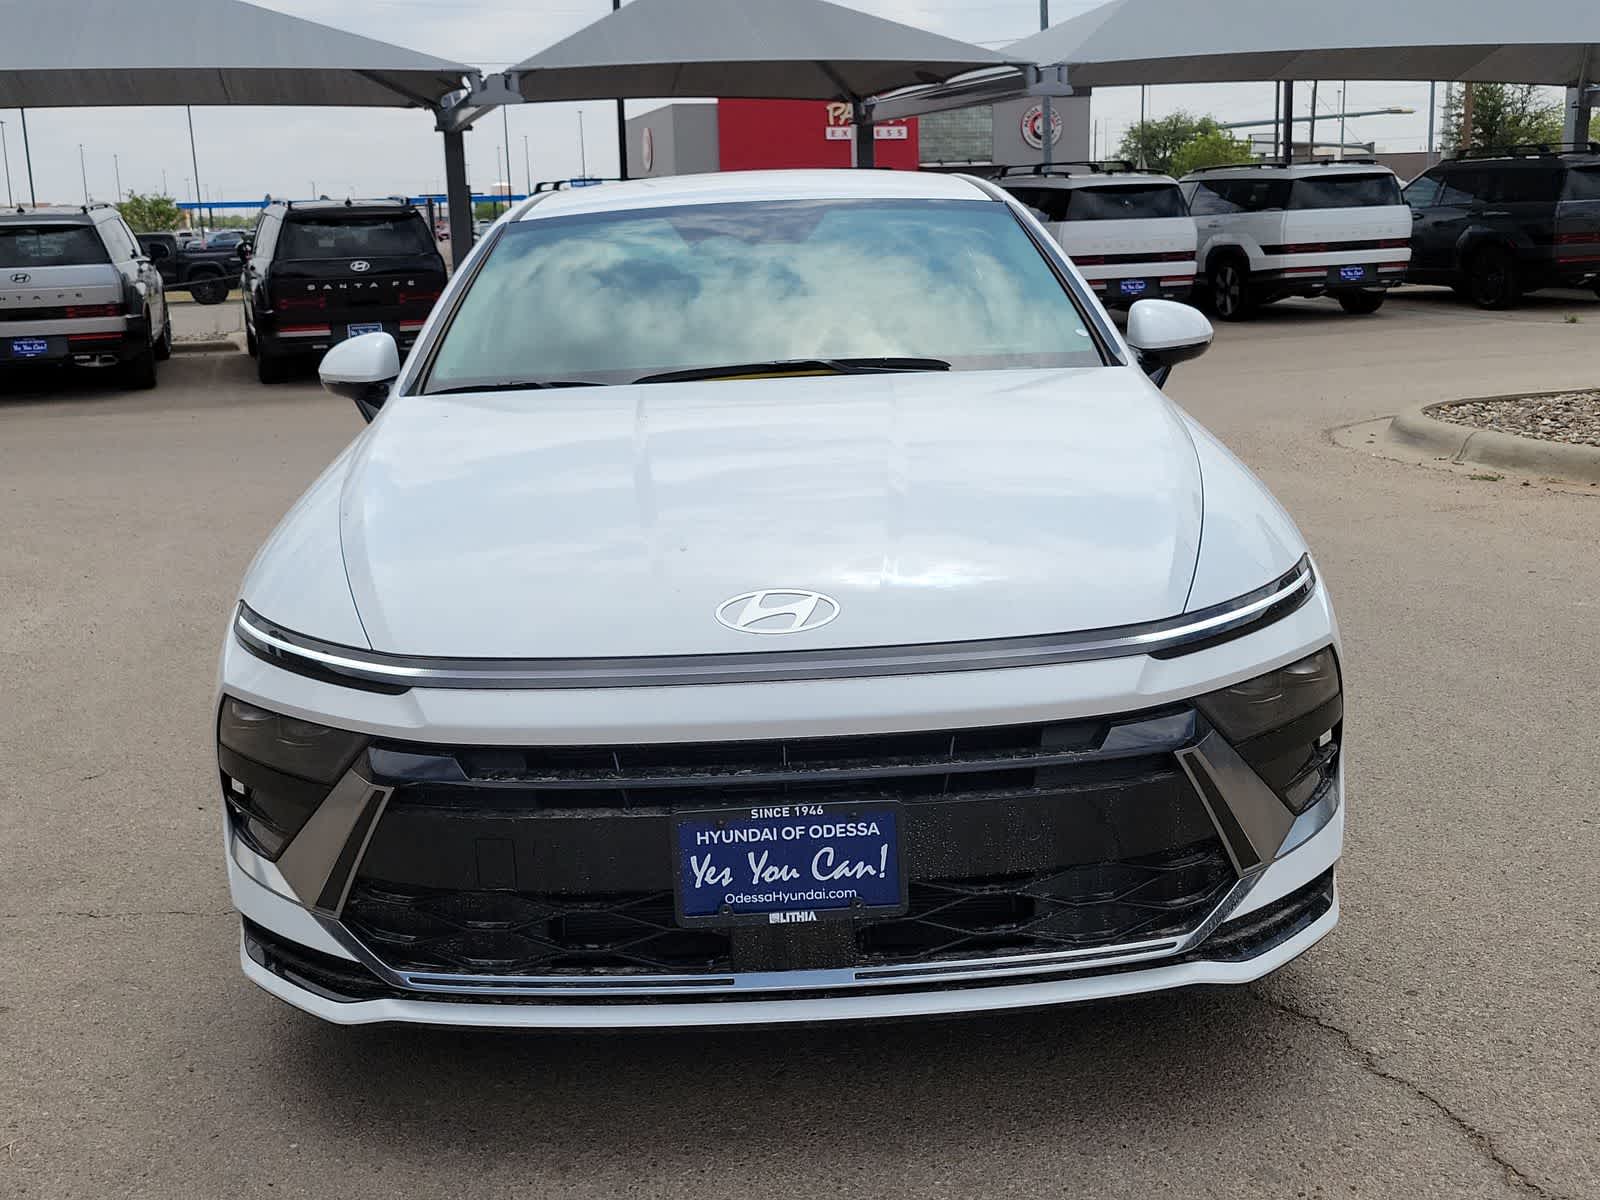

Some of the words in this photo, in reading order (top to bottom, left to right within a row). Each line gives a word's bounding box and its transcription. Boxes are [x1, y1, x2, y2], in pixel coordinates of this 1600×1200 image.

[831, 129, 904, 138] EXESS
[751, 808, 790, 819] SINCE
[794, 805, 824, 816] 1946
[696, 827, 778, 845] HYUNDAI
[781, 826, 806, 840] OF
[808, 822, 881, 839] ODESSA
[690, 853, 733, 889] Yes
[747, 849, 800, 885] You
[811, 843, 889, 881] Can!
[725, 888, 857, 904] OdessaHyundai.com
[780, 911, 817, 923] LITHIA
